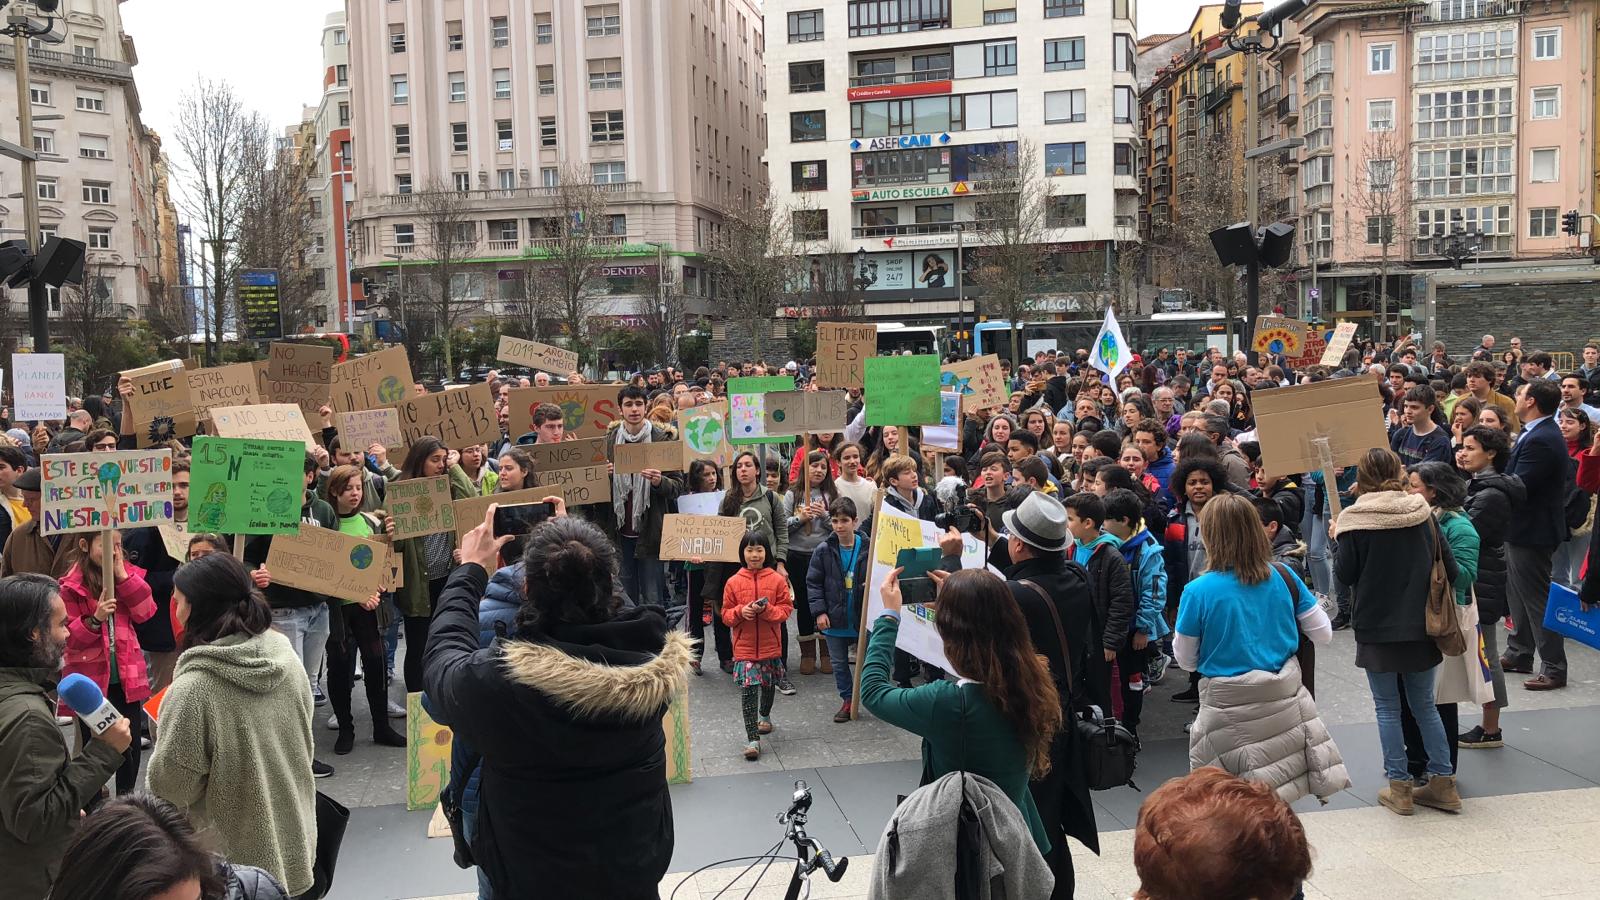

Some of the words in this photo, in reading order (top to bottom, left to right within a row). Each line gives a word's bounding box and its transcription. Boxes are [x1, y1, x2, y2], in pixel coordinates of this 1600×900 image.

[872, 189, 900, 200] AUTO
[903, 186, 949, 198] ESCUELA
[602, 267, 647, 276] DENTIX
[886, 273, 903, 281] 24/7
[1021, 299, 1080, 311] ARMACIA
[612, 318, 648, 327] ENTIX
[820, 327, 832, 341] EL
[834, 327, 875, 342] MOMENTO
[275, 347, 295, 359] NO
[504, 340, 534, 360] 2019
[836, 343, 858, 361] ES
[187, 371, 225, 389] ESTRA
[819, 363, 864, 385] AHOR
[140, 376, 174, 395] LIKE
[233, 409, 257, 427] NO
[200, 443, 227, 465] 15
[227, 455, 242, 481] M
[549, 447, 582, 464] NOS
[42, 460, 77, 480] ESTE
[82, 461, 99, 476] ES
[118, 456, 171, 475] VUESTRO
[584, 467, 602, 482] EL
[45, 482, 102, 502] PRESENTE
[563, 487, 590, 502] MPO
[44, 507, 109, 531] NUESTRO
[119, 501, 172, 523] FUTURO
[442, 503, 454, 529] B
[675, 517, 695, 526] NO
[680, 536, 724, 554] NADA
[96, 712, 117, 731] DM
